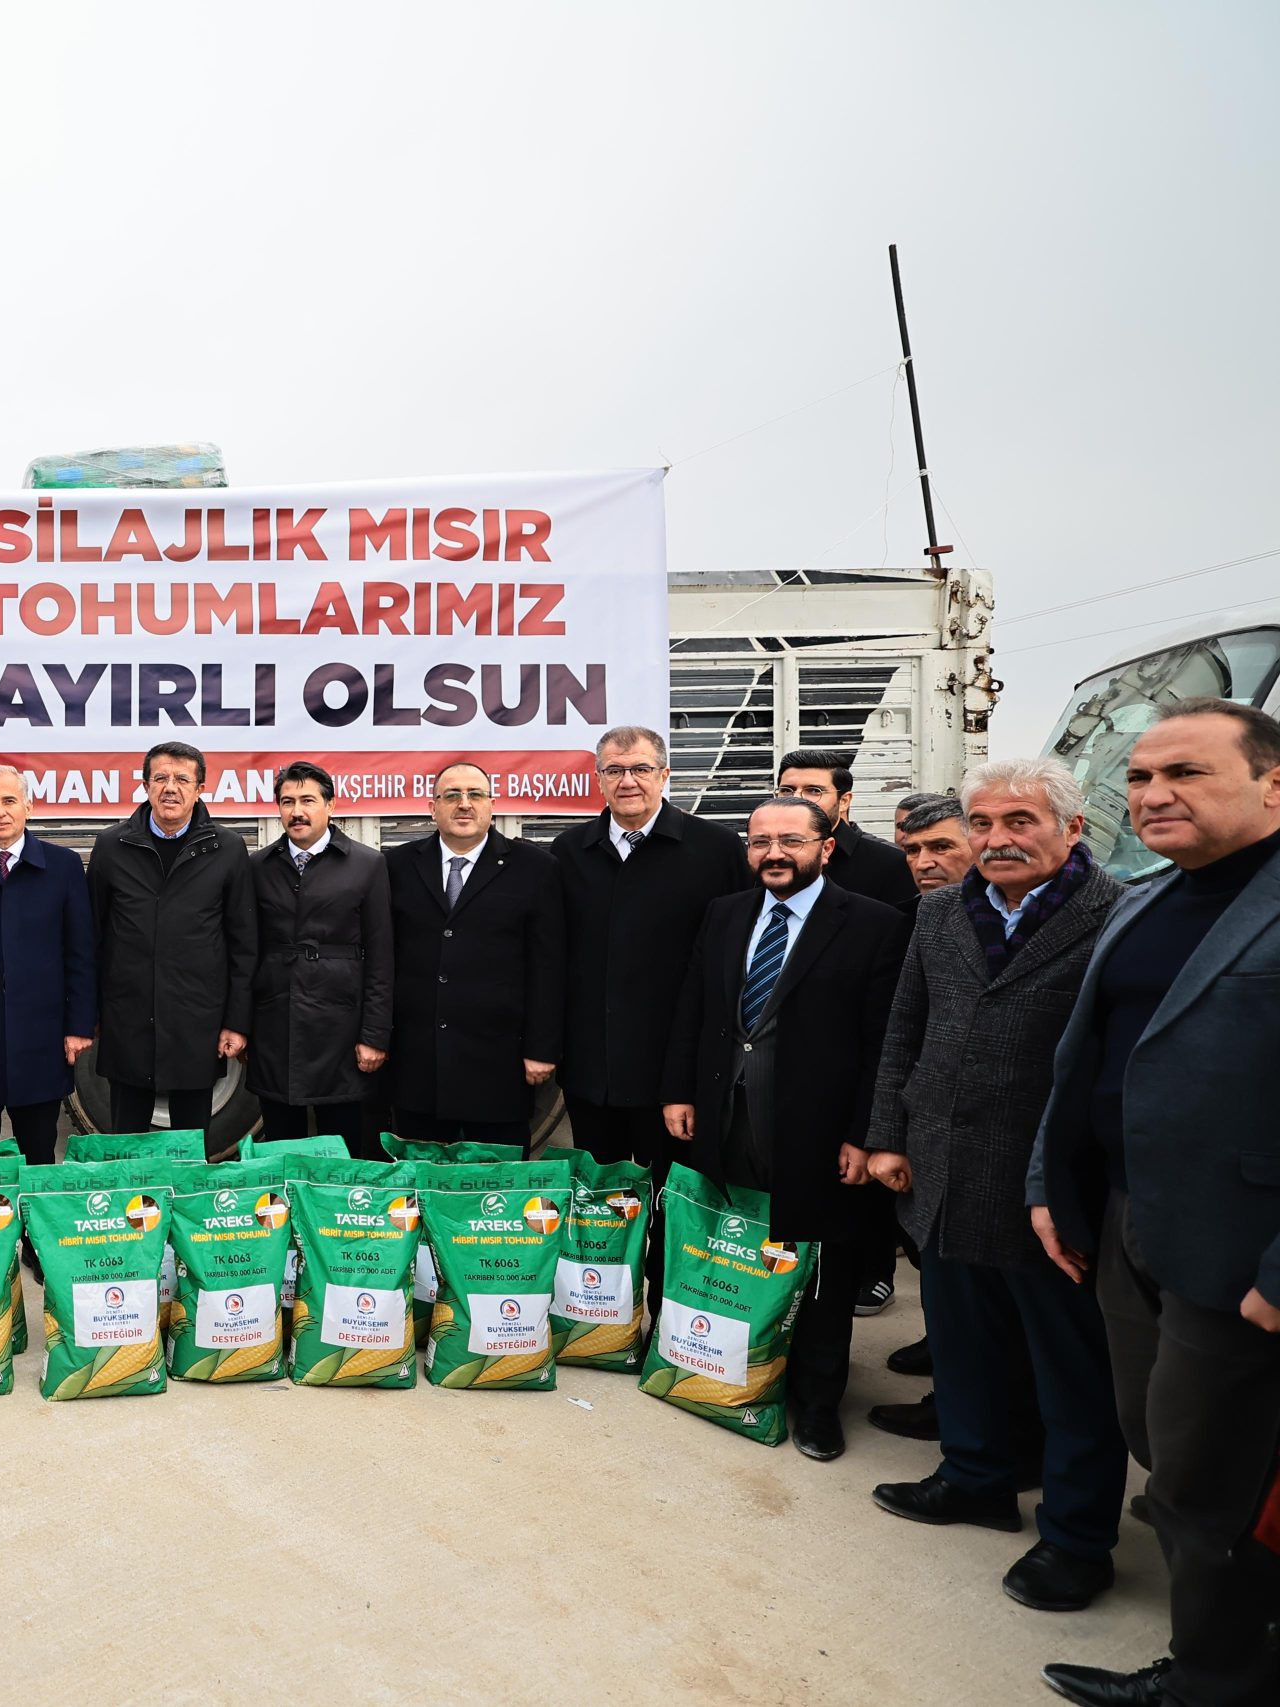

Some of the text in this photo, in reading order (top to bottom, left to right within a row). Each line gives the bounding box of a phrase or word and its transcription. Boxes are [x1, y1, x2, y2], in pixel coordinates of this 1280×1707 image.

[347, 508, 552, 562] MISIR
[302, 663, 608, 727] OLSUN
[508, 774, 589, 801] BAŞKANI
[74, 1218, 126, 1232] TAREKS
[203, 1216, 253, 1229] TAREKS
[335, 1214, 385, 1226] TAREKS
[468, 1220, 523, 1232] TAREKS
[85, 1235, 106, 1244] MISIR
[108, 1233, 144, 1243] TOHUMU
[214, 1233, 235, 1241] MISIR
[237, 1230, 272, 1240] TOHUMU
[84, 1257, 123, 1268] TK 6063
[214, 1254, 251, 1264] TK 6063
[341, 1252, 380, 1261] TK 6063
[479, 1259, 519, 1267] TK 6063
[732, 1260, 770, 1278] TOHUMU
[712, 1279, 739, 1294] 6063
[566, 1305, 618, 1317] DESTEĞİDİR
[735, 1302, 752, 1312] ADET
[781, 1290, 804, 1333] TAREKS
[92, 1329, 143, 1340] DESTEĞİDİR
[212, 1332, 262, 1343] DESTEĞİDİR
[338, 1333, 390, 1343] DESTEĞİDİR
[487, 1339, 537, 1349] DESTEĞİDİR
[669, 1350, 725, 1375] DESTEĞİDİR
